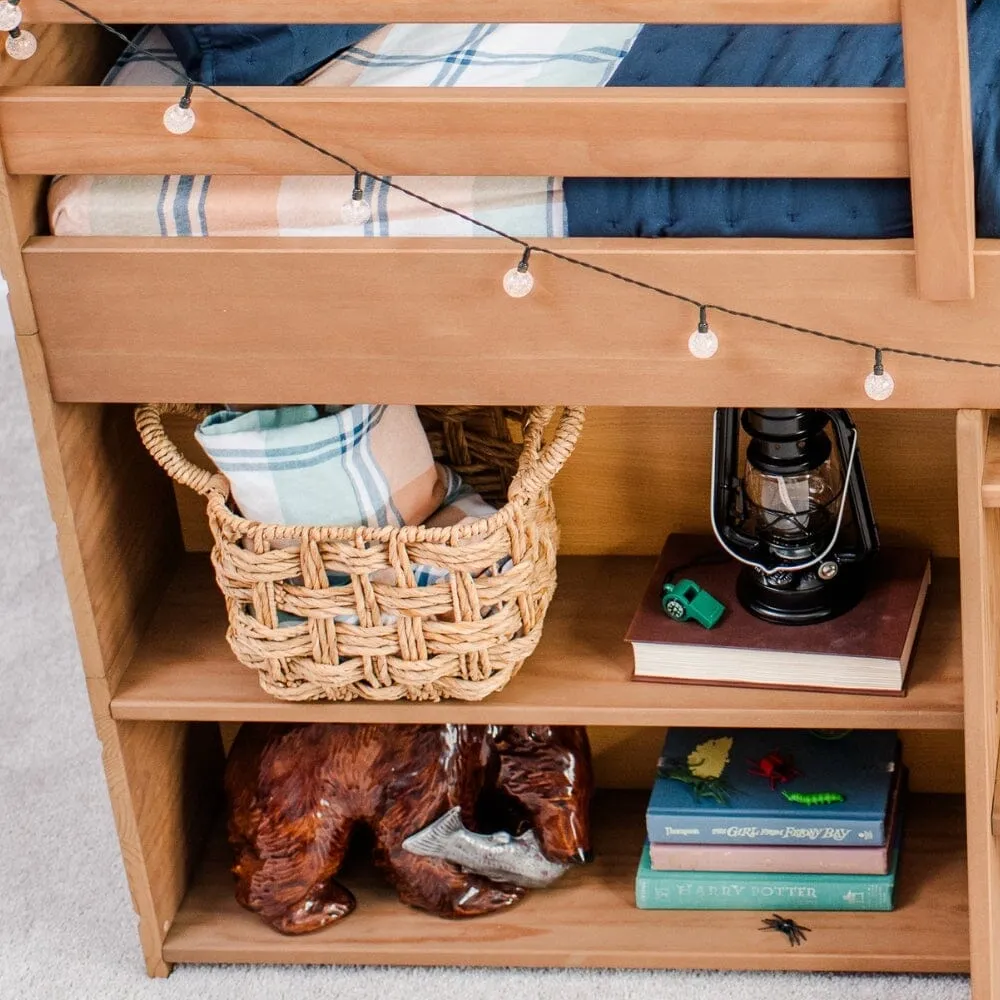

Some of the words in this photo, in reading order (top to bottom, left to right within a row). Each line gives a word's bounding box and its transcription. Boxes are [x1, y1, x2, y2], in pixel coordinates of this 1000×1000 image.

[726, 826, 759, 838] GIRL
[821, 828, 850, 841] BAY
[676, 883, 747, 897] HARRY
[752, 886, 817, 898] POTTER
